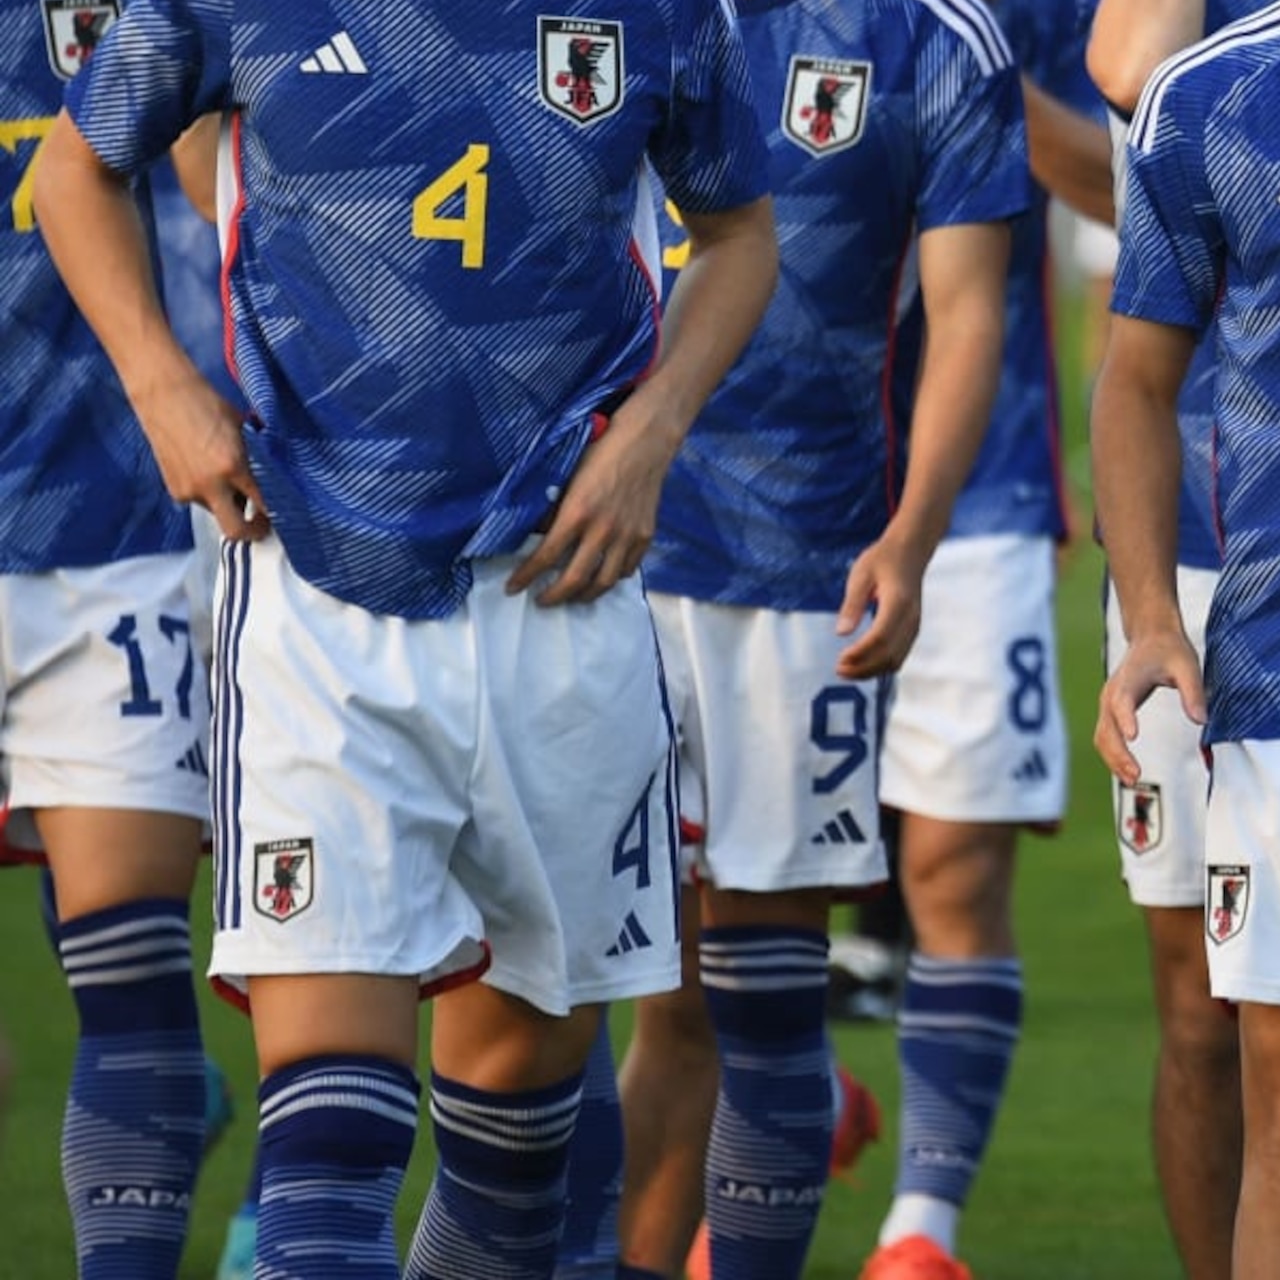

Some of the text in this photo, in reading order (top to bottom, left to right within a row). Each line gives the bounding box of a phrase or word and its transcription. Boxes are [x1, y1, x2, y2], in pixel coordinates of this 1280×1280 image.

[560, 21, 603, 34] JAPAN
[413, 144, 490, 269] 4
[106, 613, 195, 722] 17
[1005, 634, 1049, 735] 8
[809, 684, 869, 795] 9
[611, 769, 657, 890] 4
